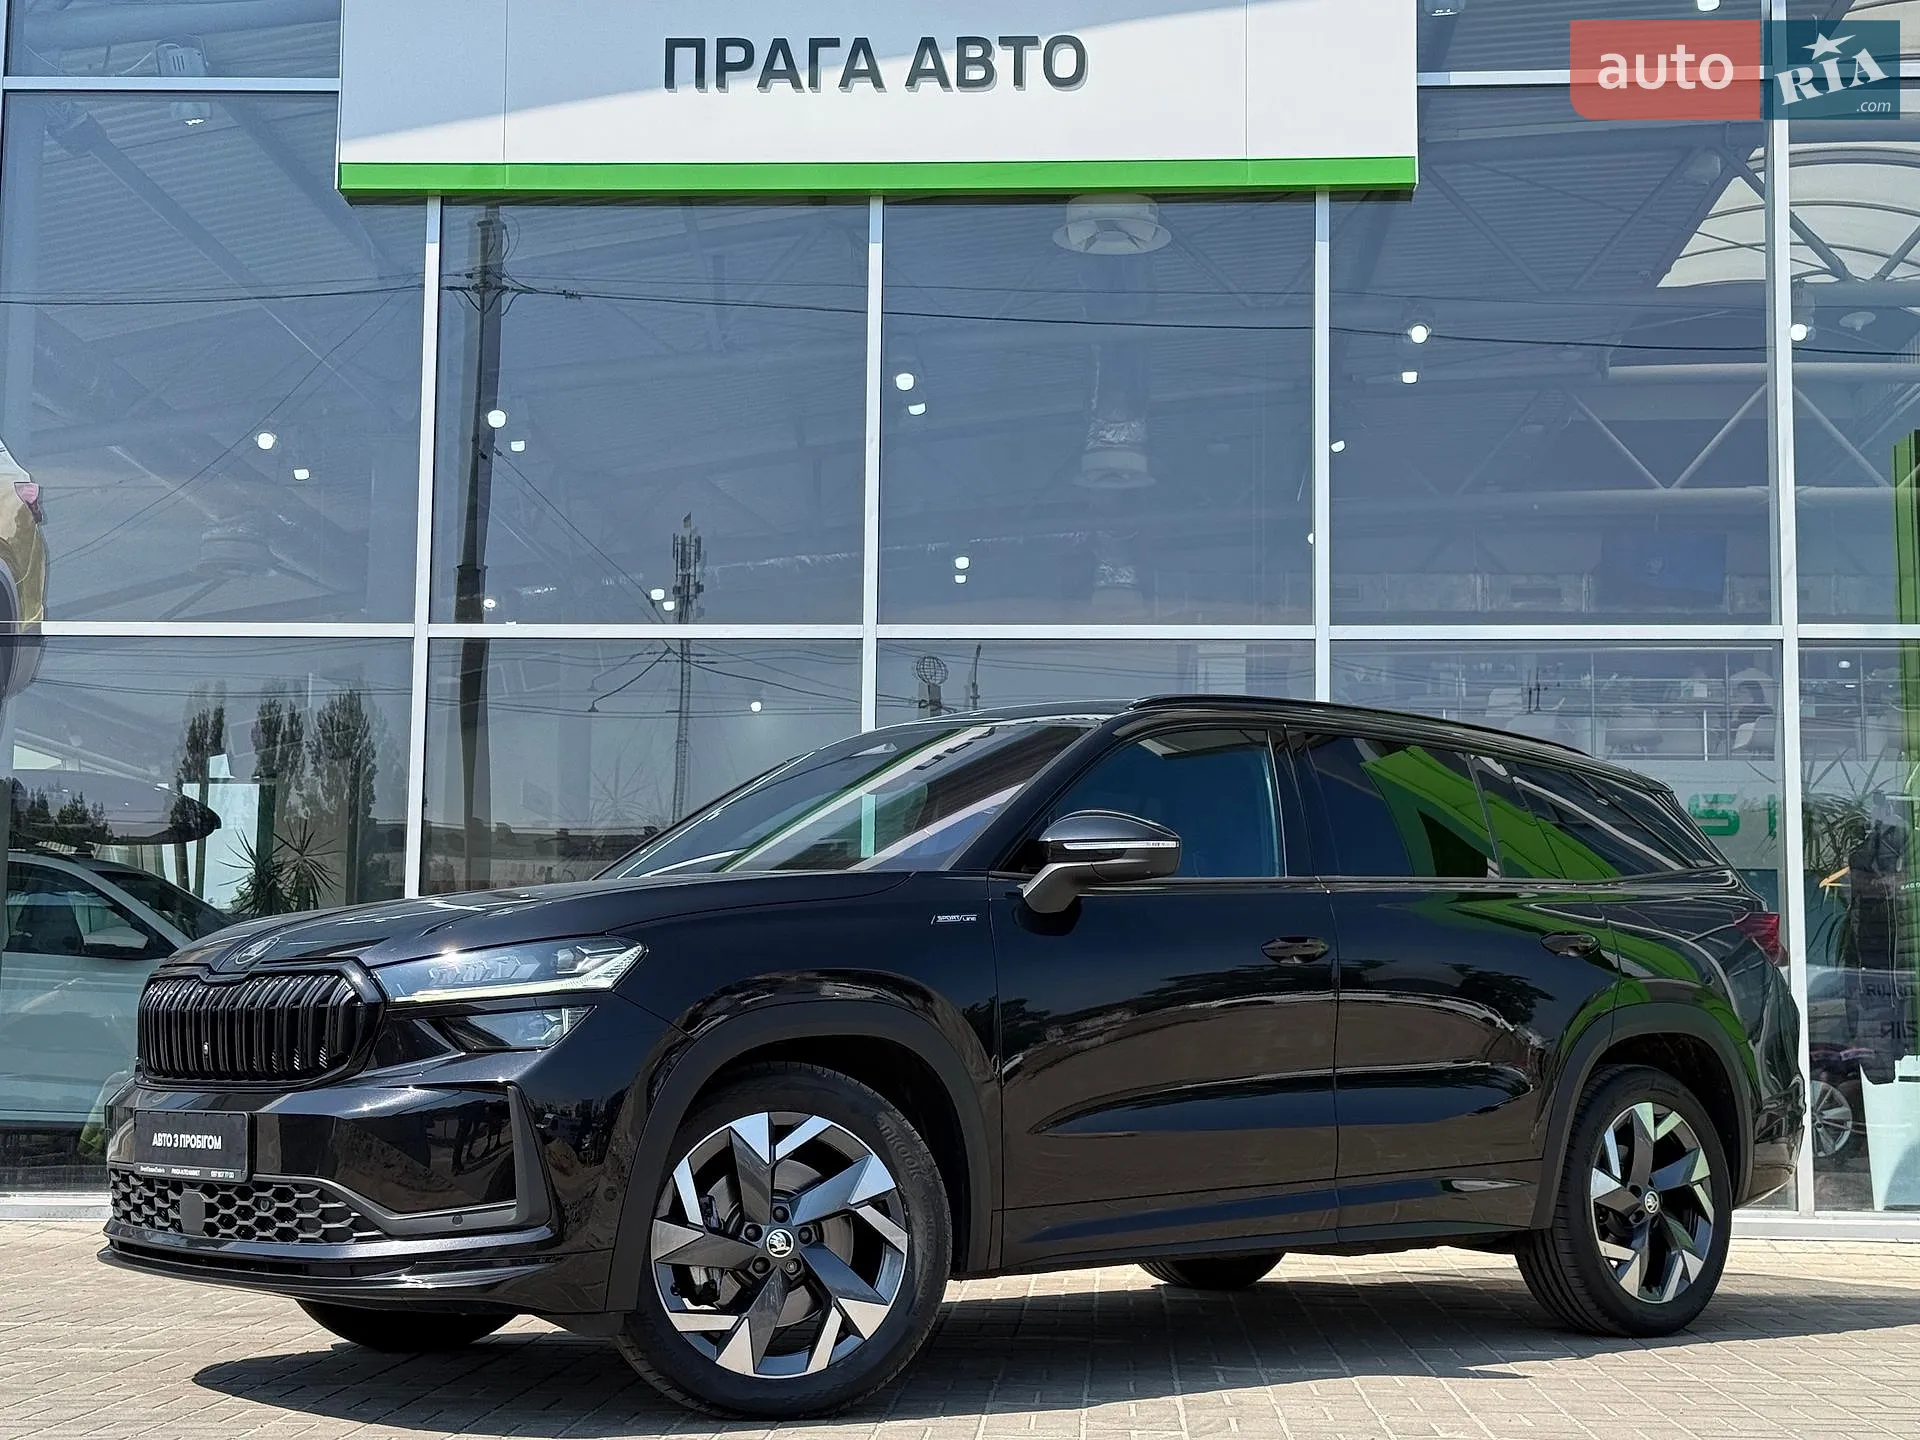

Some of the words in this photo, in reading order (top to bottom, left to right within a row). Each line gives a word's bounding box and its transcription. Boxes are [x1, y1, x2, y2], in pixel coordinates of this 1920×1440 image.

[664, 36, 886, 93] ПРАГА
[904, 34, 1088, 92] АВТО
[152, 1133, 172, 1147] АВТО
[180, 1134, 222, 1149] ПРОБІГОМ
